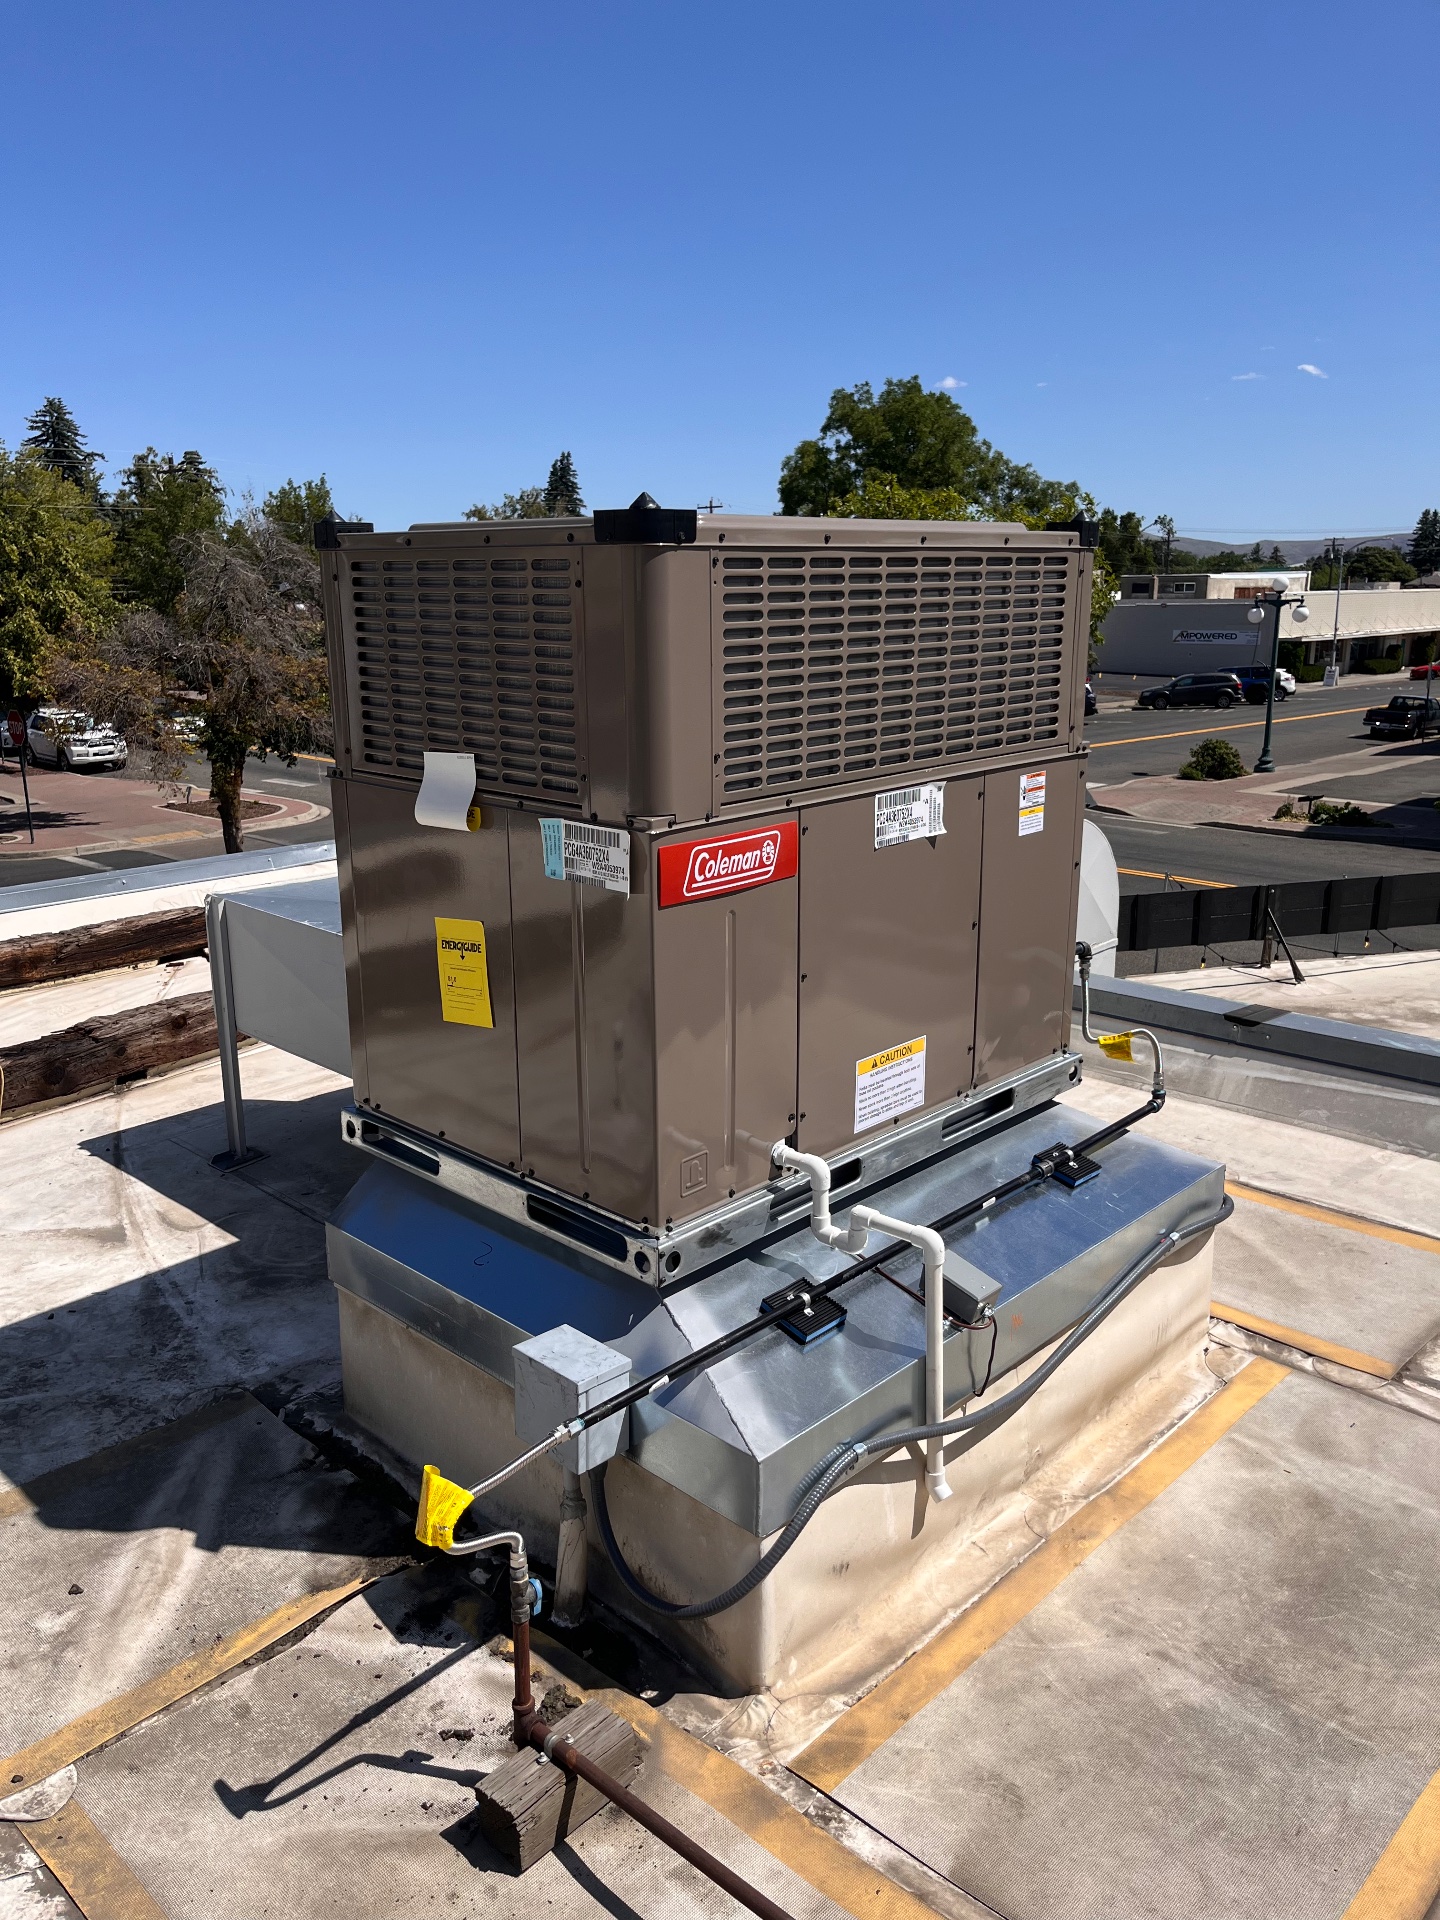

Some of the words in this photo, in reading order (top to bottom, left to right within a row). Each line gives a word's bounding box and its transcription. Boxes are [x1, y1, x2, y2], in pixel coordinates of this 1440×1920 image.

[9, 720, 23, 735] STOP
[694, 849, 761, 882] Coleman
[879, 1045, 913, 1065] CAUTION
